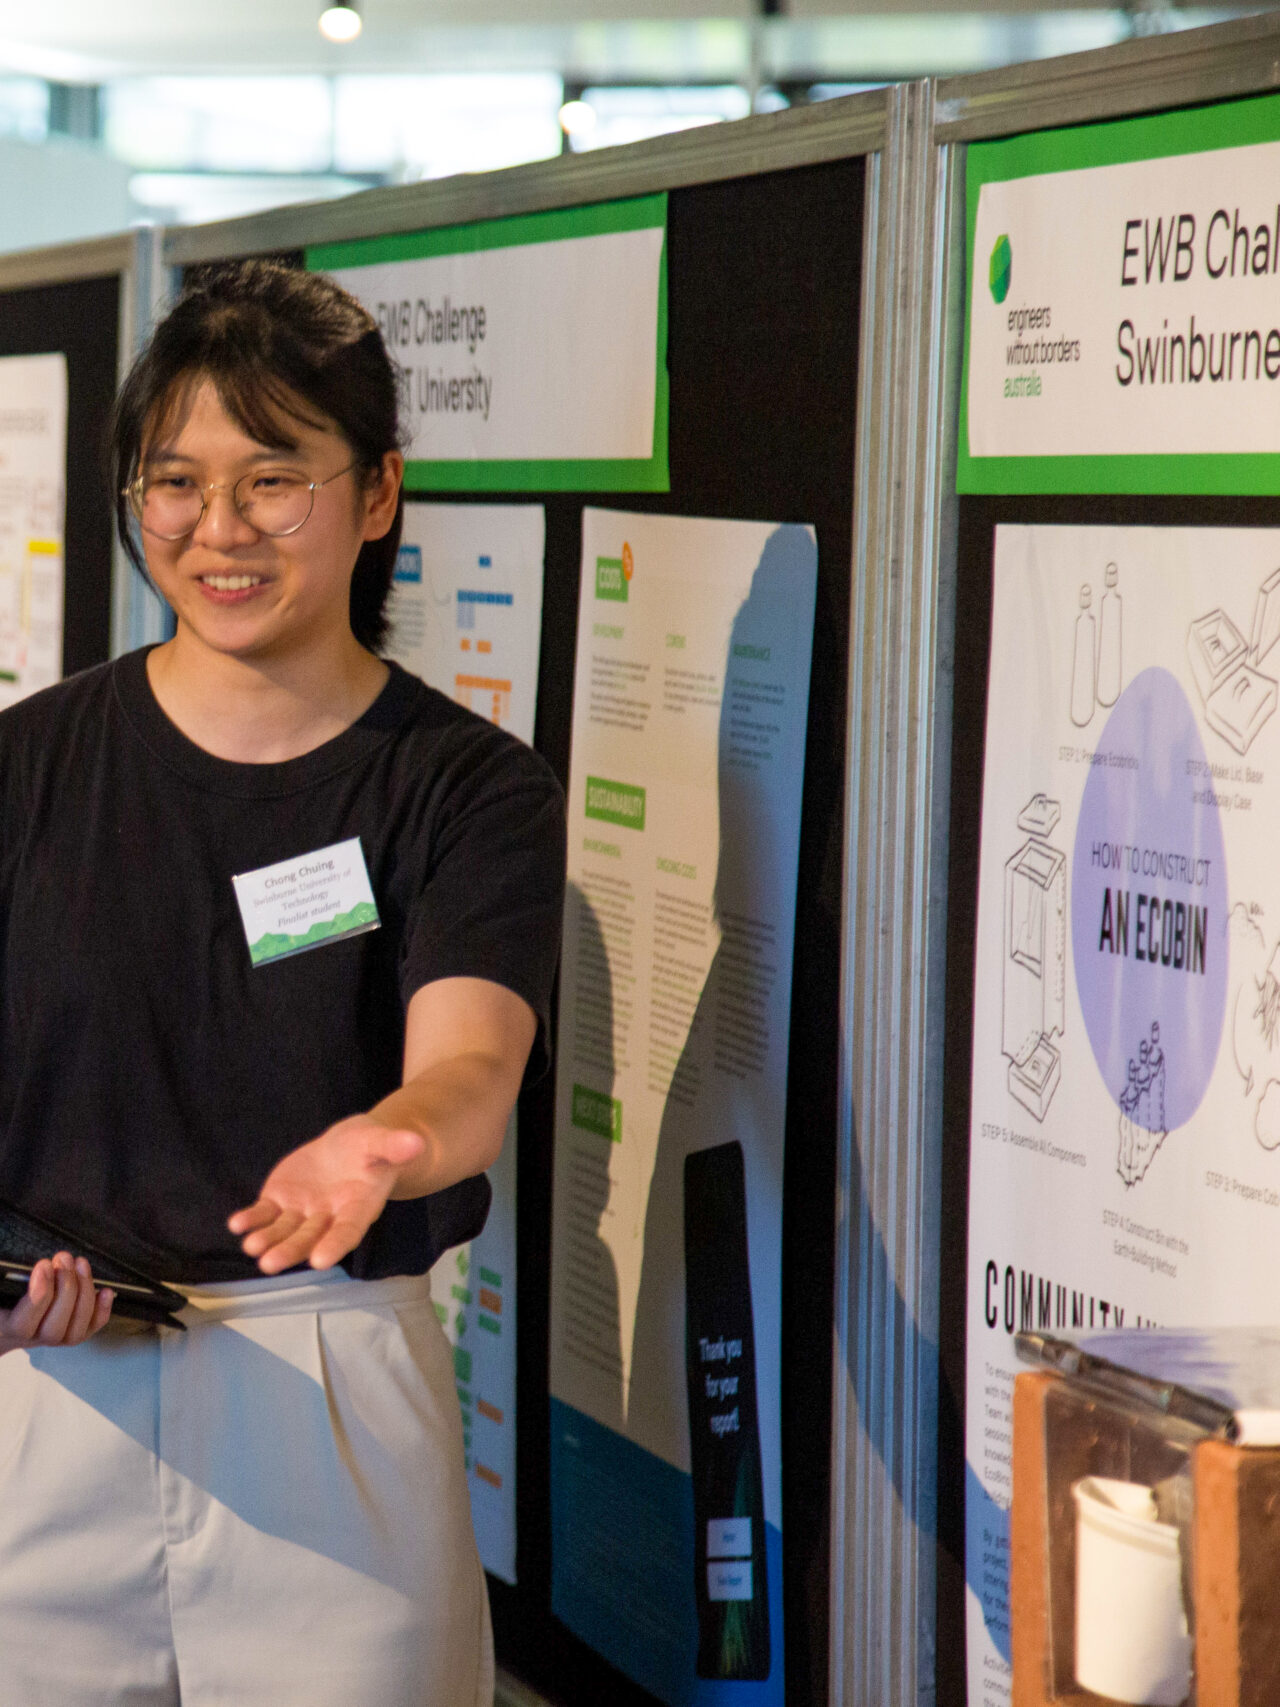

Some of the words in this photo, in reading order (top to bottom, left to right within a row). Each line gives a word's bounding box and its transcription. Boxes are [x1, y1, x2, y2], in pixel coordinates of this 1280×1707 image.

[1120, 213, 1196, 287] EWB
[1206, 204, 1280, 279] Chal
[415, 295, 487, 353] Challenge
[1008, 302, 1051, 337] engineers
[1006, 337, 1040, 366] without
[1040, 333, 1080, 364] borders
[1116, 316, 1280, 387] Swinburne
[418, 364, 491, 421] University
[1004, 369, 1041, 398] australia
[1246, 766, 1264, 784] Base
[1234, 793, 1252, 810] Case
[264, 872, 297, 889] Chong
[298, 860, 335, 878] Chuing
[1091, 840, 1123, 870] HOW
[1125, 845, 1140, 874] TO
[1143, 850, 1211, 887] CONSTRUCT
[299, 873, 341, 891] University
[278, 910, 309, 928] Finalist
[311, 900, 341, 916] student
[282, 891, 329, 911] Technology
[1099, 887, 1130, 957] AN
[1135, 893, 1208, 975] ECOBIN
[982, 1123, 1000, 1140] STEP
[1048, 1141, 1087, 1167] Components
[1206, 1170, 1224, 1189] STEP
[1233, 1178, 1262, 1202] Prepare
[1103, 1208, 1118, 1228] STEP
[700, 1335, 725, 1362] Thank
[726, 1338, 743, 1365] you
[705, 1372, 719, 1399] for
[719, 1376, 739, 1402] your
